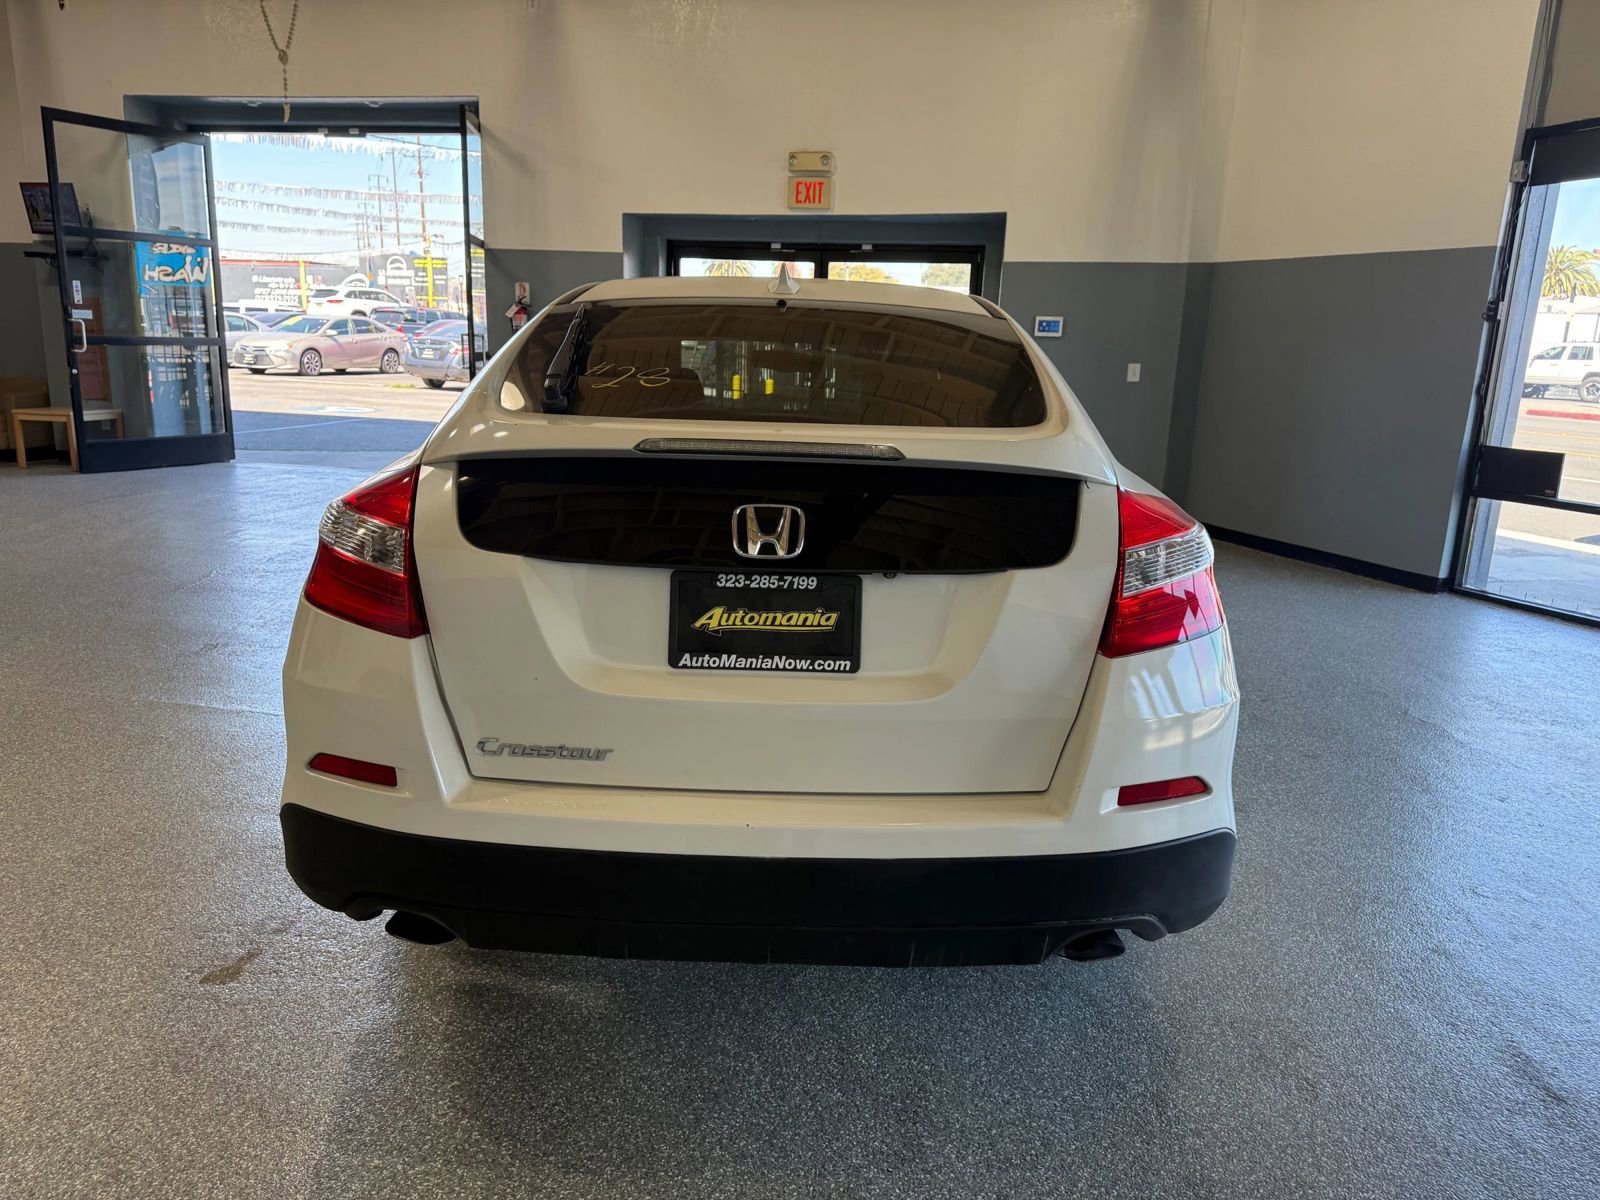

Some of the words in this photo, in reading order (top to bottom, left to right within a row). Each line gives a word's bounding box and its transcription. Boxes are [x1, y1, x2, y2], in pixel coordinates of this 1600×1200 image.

[795, 181, 824, 204] EXIT
[716, 574, 818, 590] 323-285-7199
[692, 606, 840, 632] Automania
[678, 653, 851, 672] AutoManiaNow.com
[475, 737, 614, 762] Crosstour
